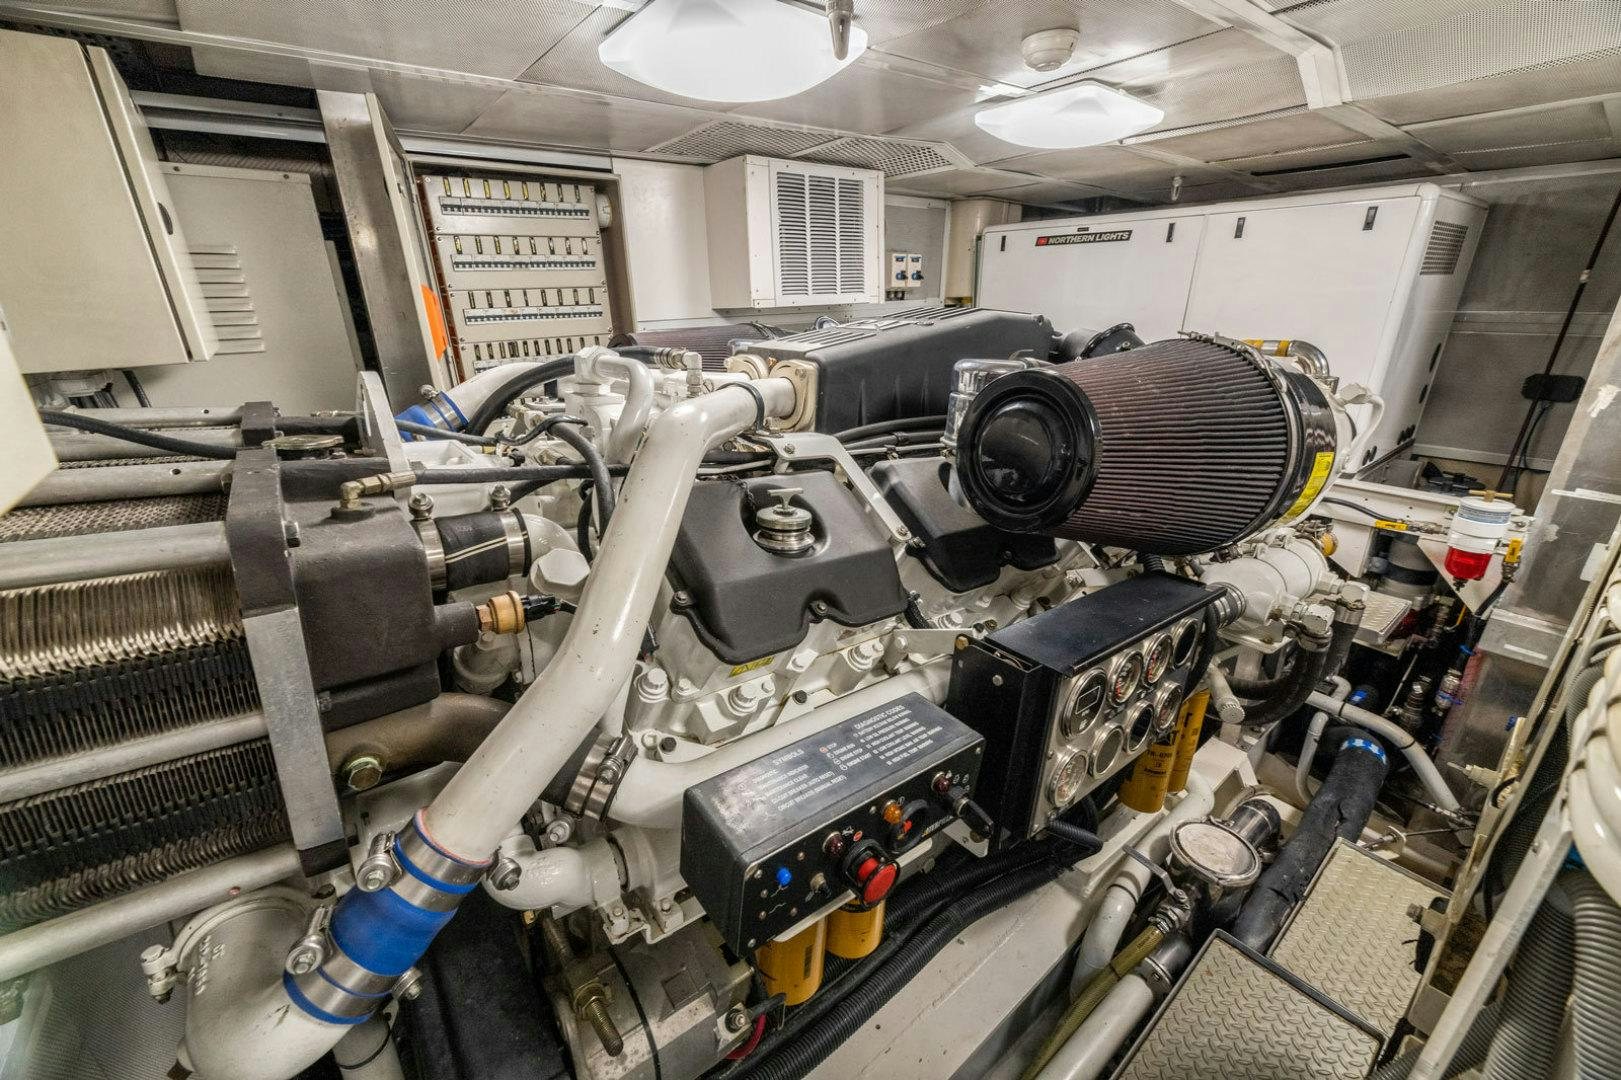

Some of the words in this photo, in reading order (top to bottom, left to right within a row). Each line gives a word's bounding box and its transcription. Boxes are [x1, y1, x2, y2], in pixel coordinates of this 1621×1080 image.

[1048, 234, 1095, 244] NORTHERN
[1096, 231, 1129, 241] LIGHTS
[853, 712, 888, 729] DIAGNOSTIC
[884, 704, 905, 715] CODES
[771, 748, 805, 765] SYMBOLS
